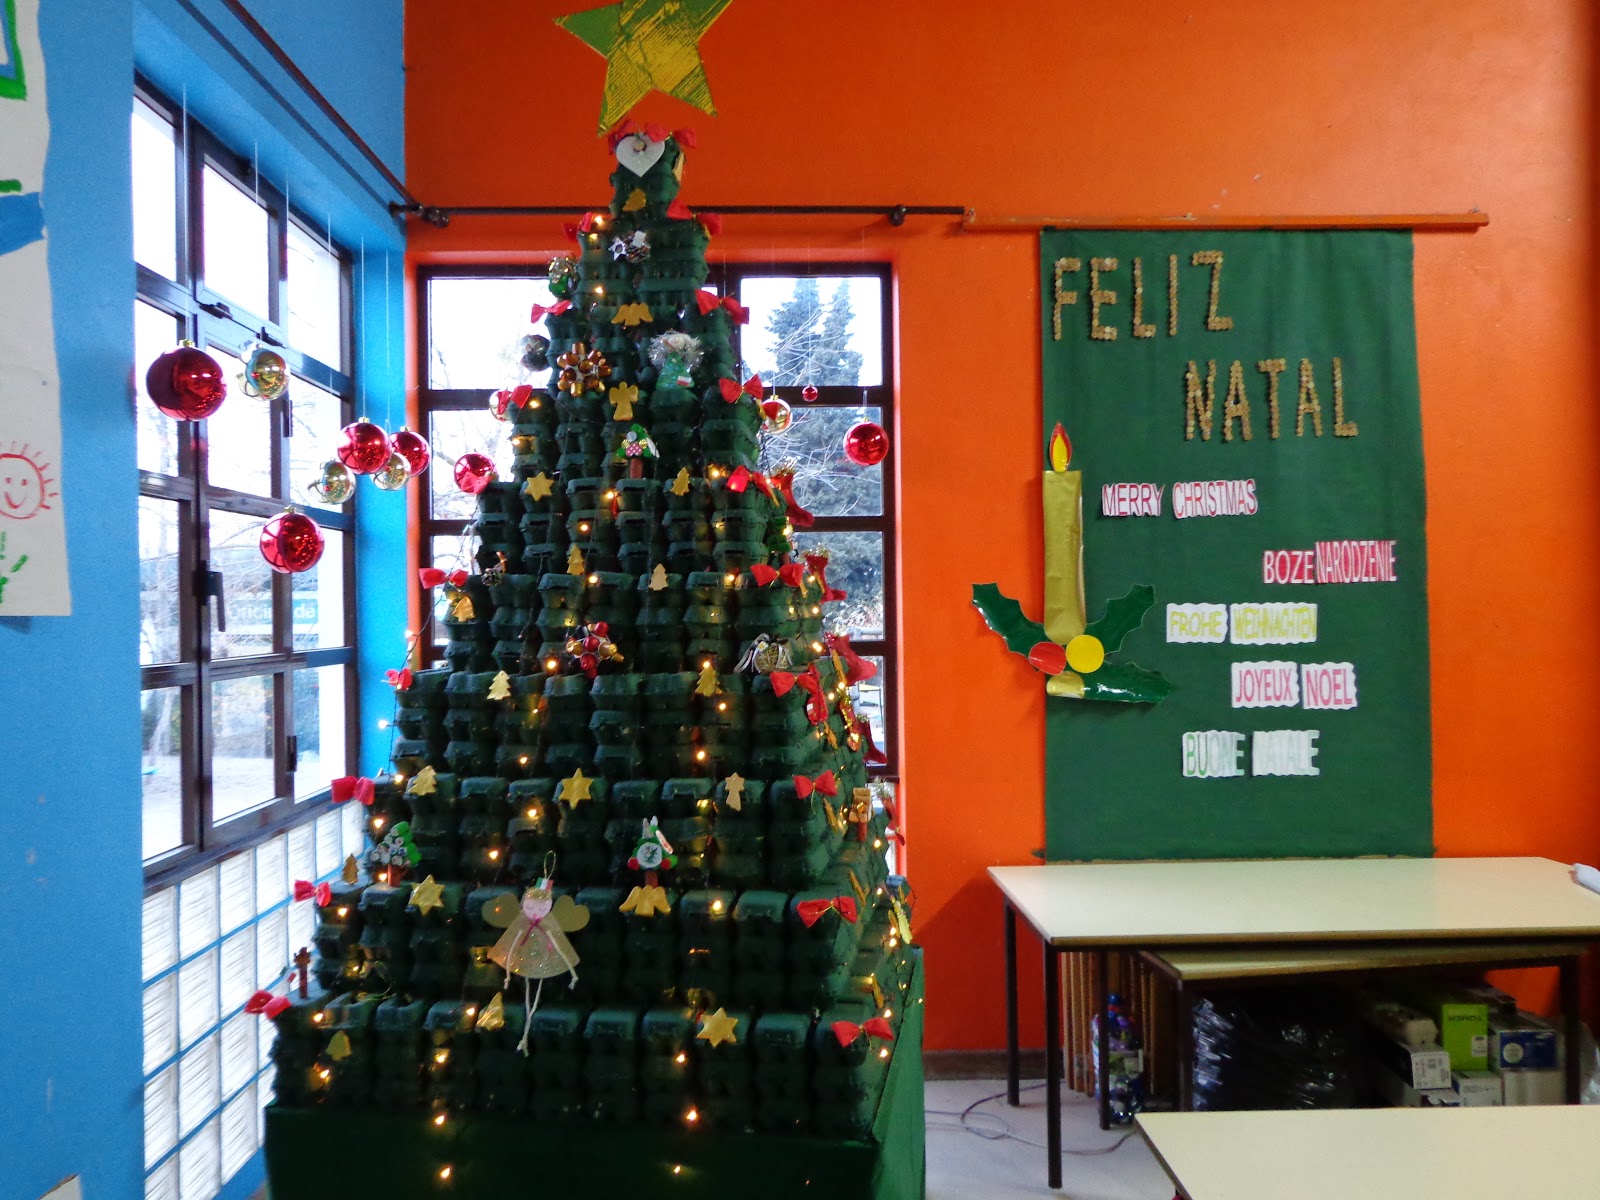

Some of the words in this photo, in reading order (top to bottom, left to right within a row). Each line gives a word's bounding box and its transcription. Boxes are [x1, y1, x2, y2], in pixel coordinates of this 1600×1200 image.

[1053, 250, 1233, 341] FELIZ
[1185, 356, 1358, 442] NATAL
[1102, 483, 1164, 517] MERRY
[1172, 479, 1258, 518] CHRISTMAS
[1264, 551, 1315, 584] BOZE
[1315, 540, 1397, 583] NARODZENIE
[294, 603, 316, 619] de
[1170, 610, 1223, 637] FROHE
[1235, 668, 1293, 703] JOYEUX
[1306, 669, 1353, 706] NOEL
